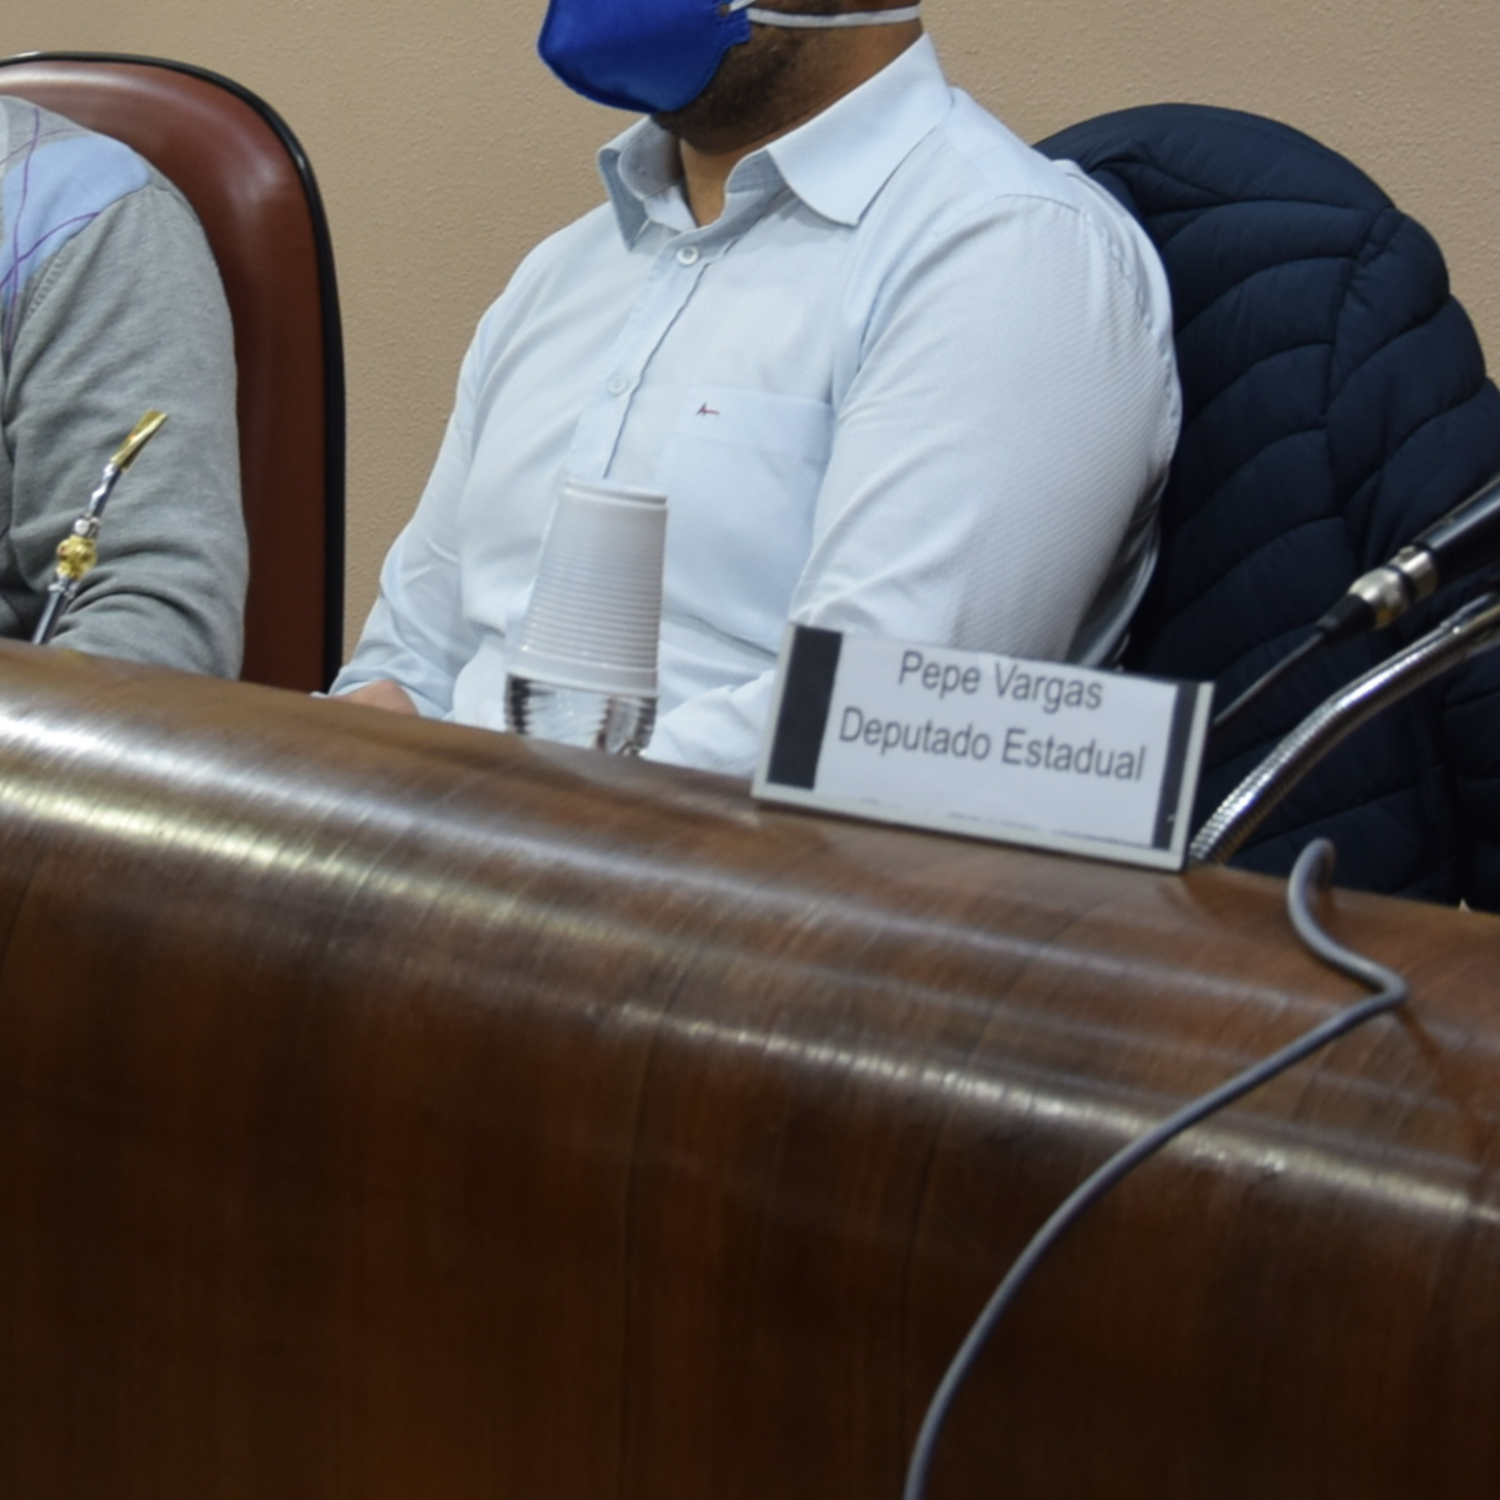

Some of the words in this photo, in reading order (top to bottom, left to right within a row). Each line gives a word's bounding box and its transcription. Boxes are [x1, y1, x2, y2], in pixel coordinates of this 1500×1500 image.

[898, 650, 981, 699] Pepe
[994, 661, 1104, 714] Vargas
[839, 706, 992, 761] Deputado
[1001, 727, 1147, 782] Estadual
